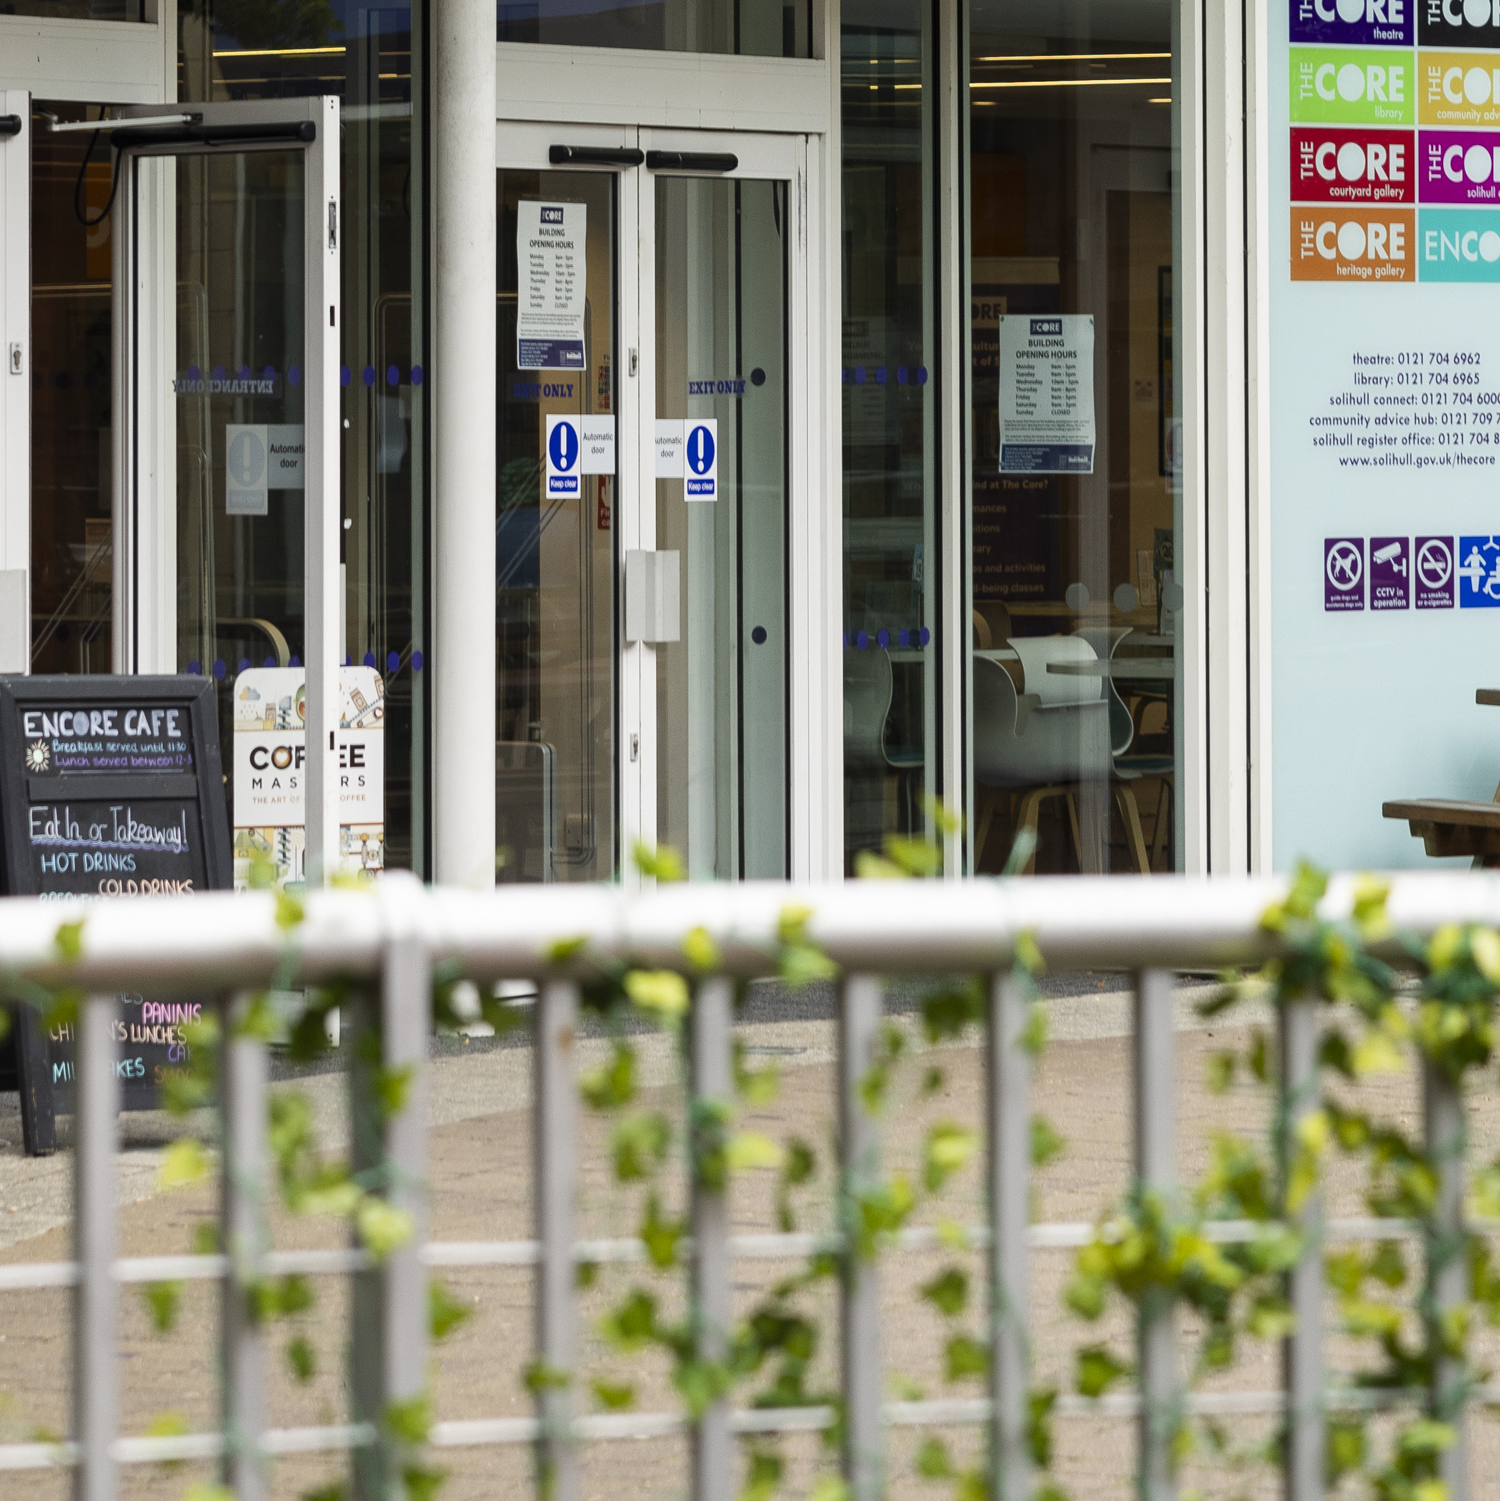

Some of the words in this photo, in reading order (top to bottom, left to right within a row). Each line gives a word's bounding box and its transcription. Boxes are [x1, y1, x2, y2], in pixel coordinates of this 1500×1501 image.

[1373, 28, 1405, 41] theatre
[1300, 61, 1313, 100] THE
[1315, 63, 1405, 102] CORE
[1428, 65, 1441, 104] THE
[1374, 105, 1404, 122] library
[1436, 108, 1482, 123] community
[1300, 141, 1314, 180] THE
[1315, 141, 1405, 182] CORE
[1428, 144, 1441, 182] THE
[1329, 185, 1372, 200] courtyard
[1374, 186, 1405, 200] gallery
[1467, 186, 1496, 199] solihull
[545, 210, 562, 222] CORE
[539, 228, 565, 237] BUILDING
[529, 240, 554, 248] OPENING
[555, 241, 574, 250] HOURS
[1301, 220, 1314, 259] THE
[1315, 221, 1406, 261] CORE
[1336, 264, 1373, 278] heritage
[1375, 265, 1406, 279] gallery
[1037, 322, 1060, 332] CORE
[1028, 339, 1065, 348] BUILDING
[1015, 350, 1050, 359] OPENING
[1051, 350, 1077, 359] HOURS
[1352, 353, 1394, 366] theatre:
[1397, 353, 1425, 365] 0121
[1429, 353, 1450, 365] 704
[1453, 352, 1481, 365] 6962
[688, 381, 715, 395] EXIT
[717, 380, 746, 394] ONLY
[1353, 373, 1394, 388] library:
[1397, 373, 1424, 385] 0121
[1428, 373, 1449, 385] 704
[1452, 373, 1480, 385] 6965
[513, 383, 541, 398] EXIT
[543, 384, 574, 398] ONLY
[1329, 393, 1370, 406] solihull
[1373, 394, 1418, 405] connect:
[1421, 393, 1448, 405] 0121
[1452, 393, 1473, 405] 704
[1309, 413, 1371, 428] community
[1374, 413, 1410, 426] advice
[1413, 413, 1438, 425] hub:
[1441, 413, 1468, 425] 0121
[1472, 413, 1493, 425] 709
[583, 432, 614, 442] Automatic
[1312, 433, 1353, 446] solihull
[1356, 433, 1398, 449] register
[1401, 433, 1435, 446] office:
[1438, 433, 1465, 445] 0121
[1469, 433, 1490, 445] 704
[591, 445, 605, 455] door
[660, 449, 675, 459] door
[280, 457, 298, 468] door
[1338, 452, 1496, 469] www.solihull.gov.uk/thecore
[550, 479, 564, 490] Keep
[564, 479, 577, 489] clear
[688, 482, 701, 492] Keep
[702, 481, 714, 491] clear
[1002, 480, 1020, 489] The
[1022, 479, 1048, 489] Core?
[985, 564, 1002, 573] and
[1005, 563, 1046, 573] activities
[1011, 583, 1044, 593] classes
[1376, 587, 1395, 597] CCTV
[1373, 597, 1407, 609] operation
[23, 709, 119, 738] ENCORE
[124, 709, 181, 738] CAFE
[52, 738, 104, 754] Breakfast
[106, 740, 138, 752] served
[140, 740, 165, 753] until
[55, 754, 90, 767] Lunch
[93, 755, 128, 767] served
[131, 754, 173, 767] between
[249, 744, 366, 771] COFEE
[252, 775, 366, 790] MASRS
[253, 796, 268, 804] THE
[271, 795, 286, 804] ART
[29, 805, 62, 840] Eat
[65, 805, 82, 840] In
[89, 822, 108, 841] or
[110, 805, 188, 854] Takeaway!
[41, 852, 79, 874] HOT
[83, 851, 137, 873] DRINKS
[98, 878, 139, 898] COLD
[140, 878, 195, 899] DRINKS
[142, 1001, 202, 1025] PANINIS
[130, 1023, 187, 1044] LUNCHES
